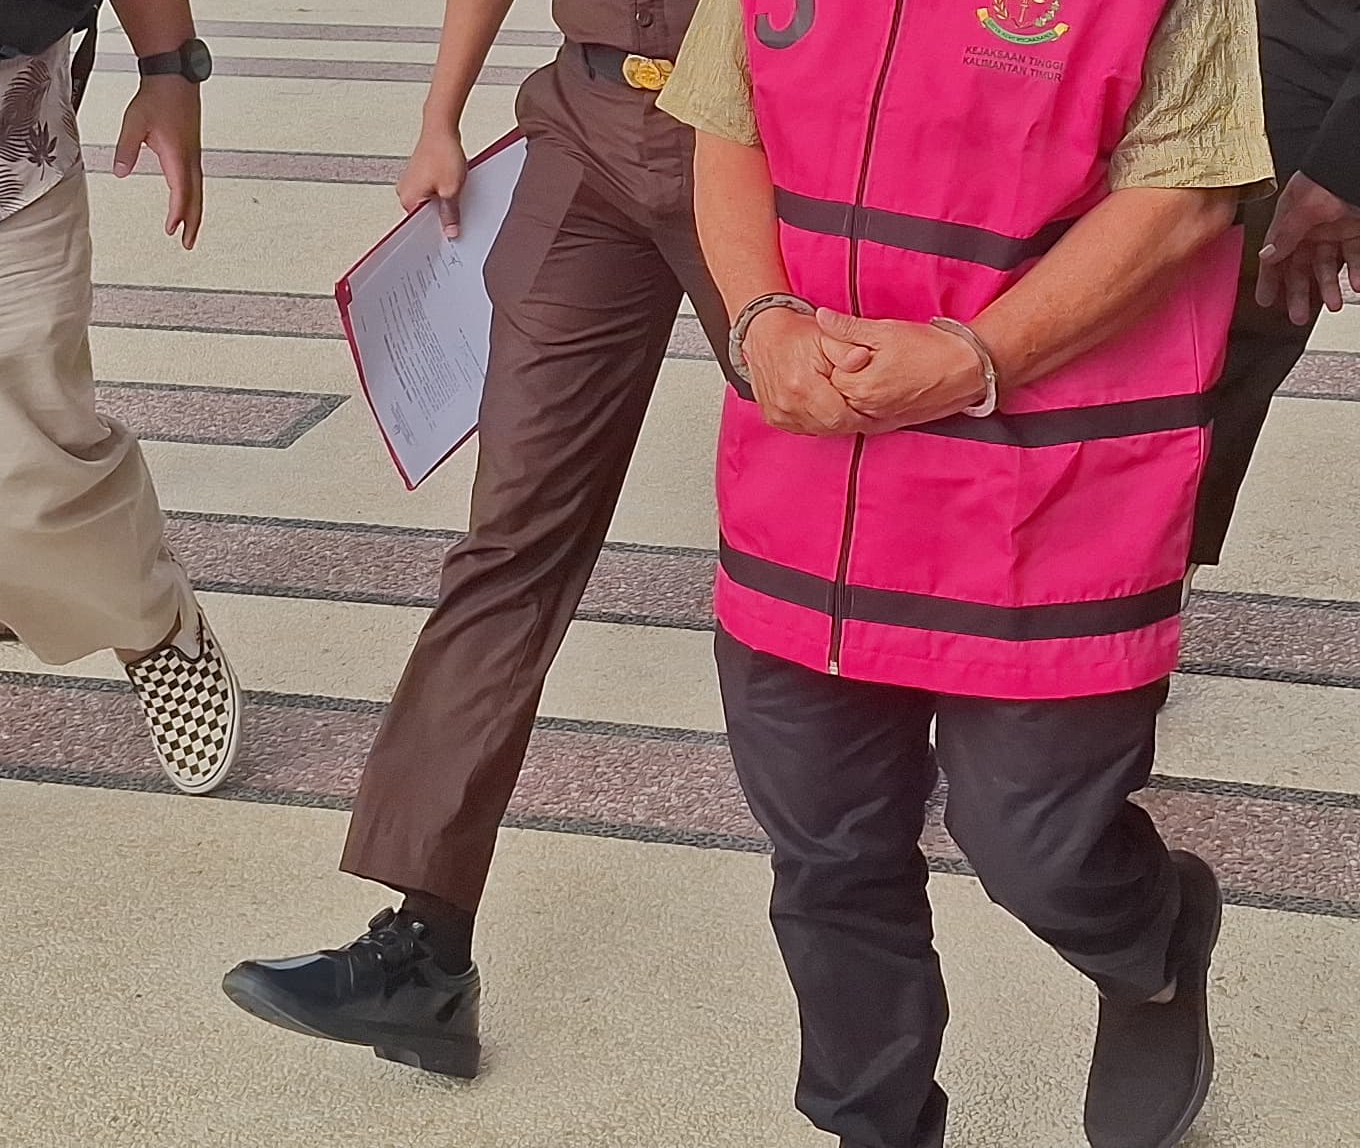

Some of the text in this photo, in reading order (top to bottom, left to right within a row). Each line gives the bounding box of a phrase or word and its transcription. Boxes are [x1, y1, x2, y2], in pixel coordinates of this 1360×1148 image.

[962, 56, 1063, 83] KALIMANTAN TIMUR
[964, 45, 1064, 71] KEJAKSAAN TINGGI
